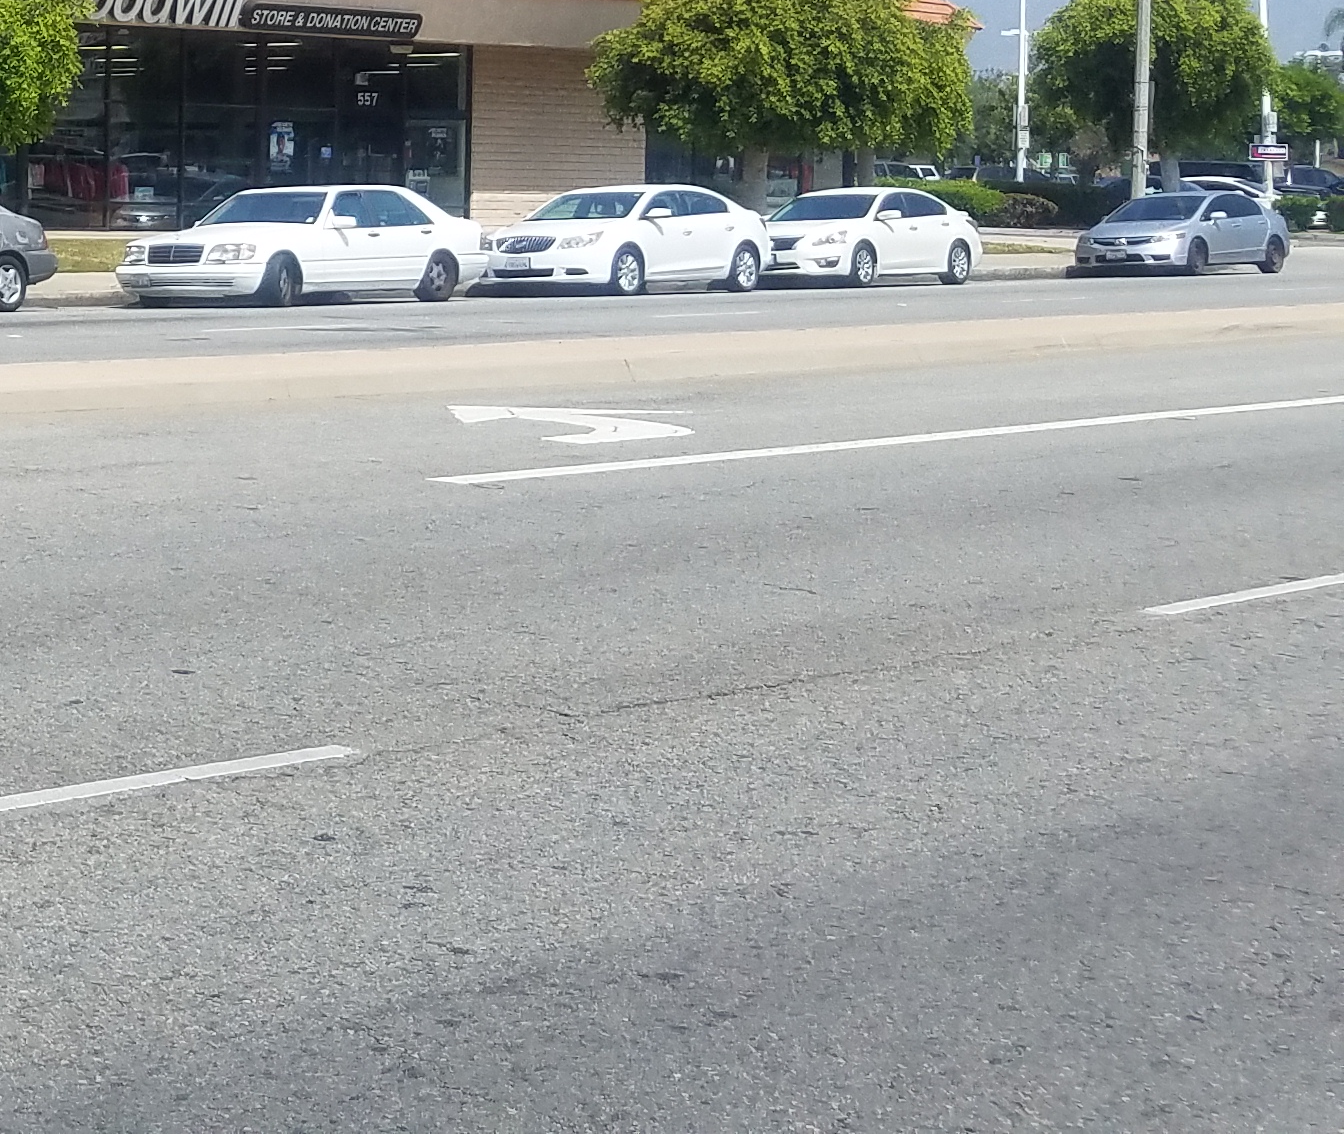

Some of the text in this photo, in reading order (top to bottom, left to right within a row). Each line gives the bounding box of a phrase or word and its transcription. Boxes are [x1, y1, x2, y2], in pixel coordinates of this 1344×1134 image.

[251, 9, 419, 33] STORE & DONATION CENTER
[357, 92, 379, 107] 557
